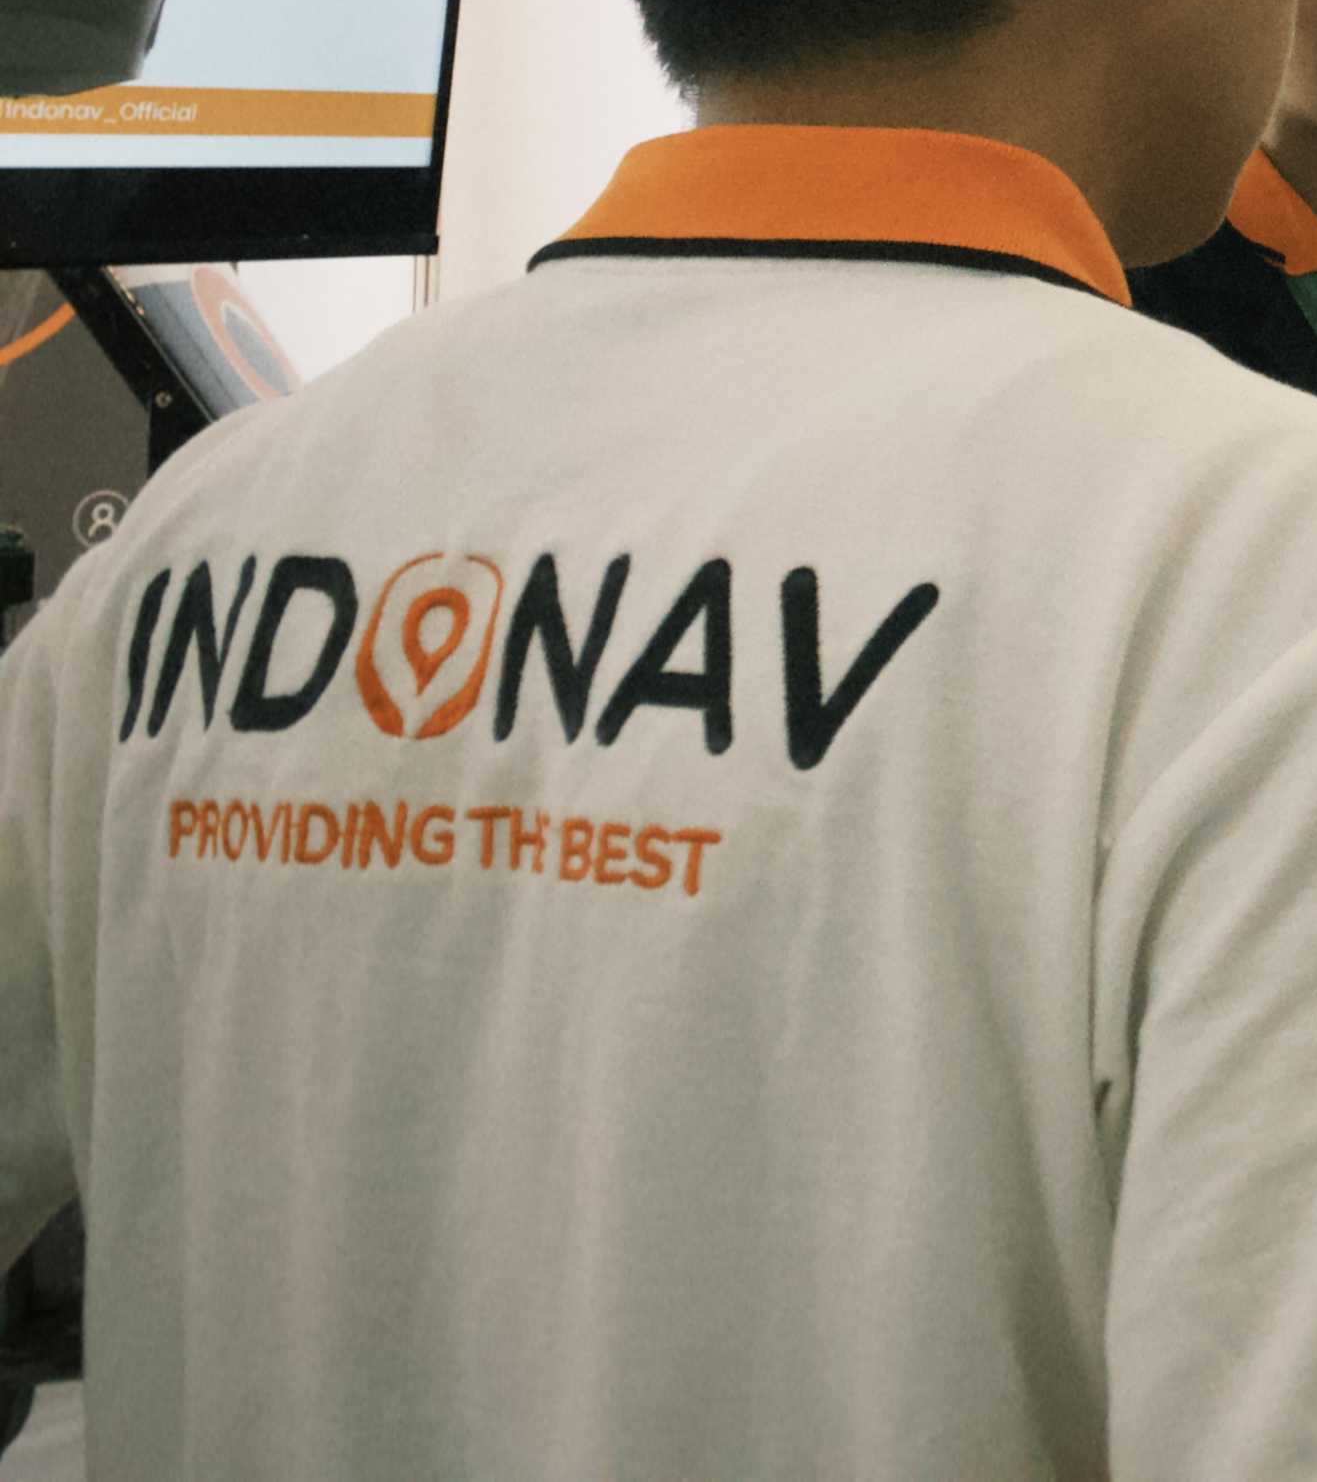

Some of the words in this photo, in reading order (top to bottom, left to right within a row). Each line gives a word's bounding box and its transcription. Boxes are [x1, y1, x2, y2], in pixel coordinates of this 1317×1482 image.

[118, 550, 940, 771] INDONAV
[167, 799, 456, 871] PROVIDING
[560, 818, 722, 898] BEST
